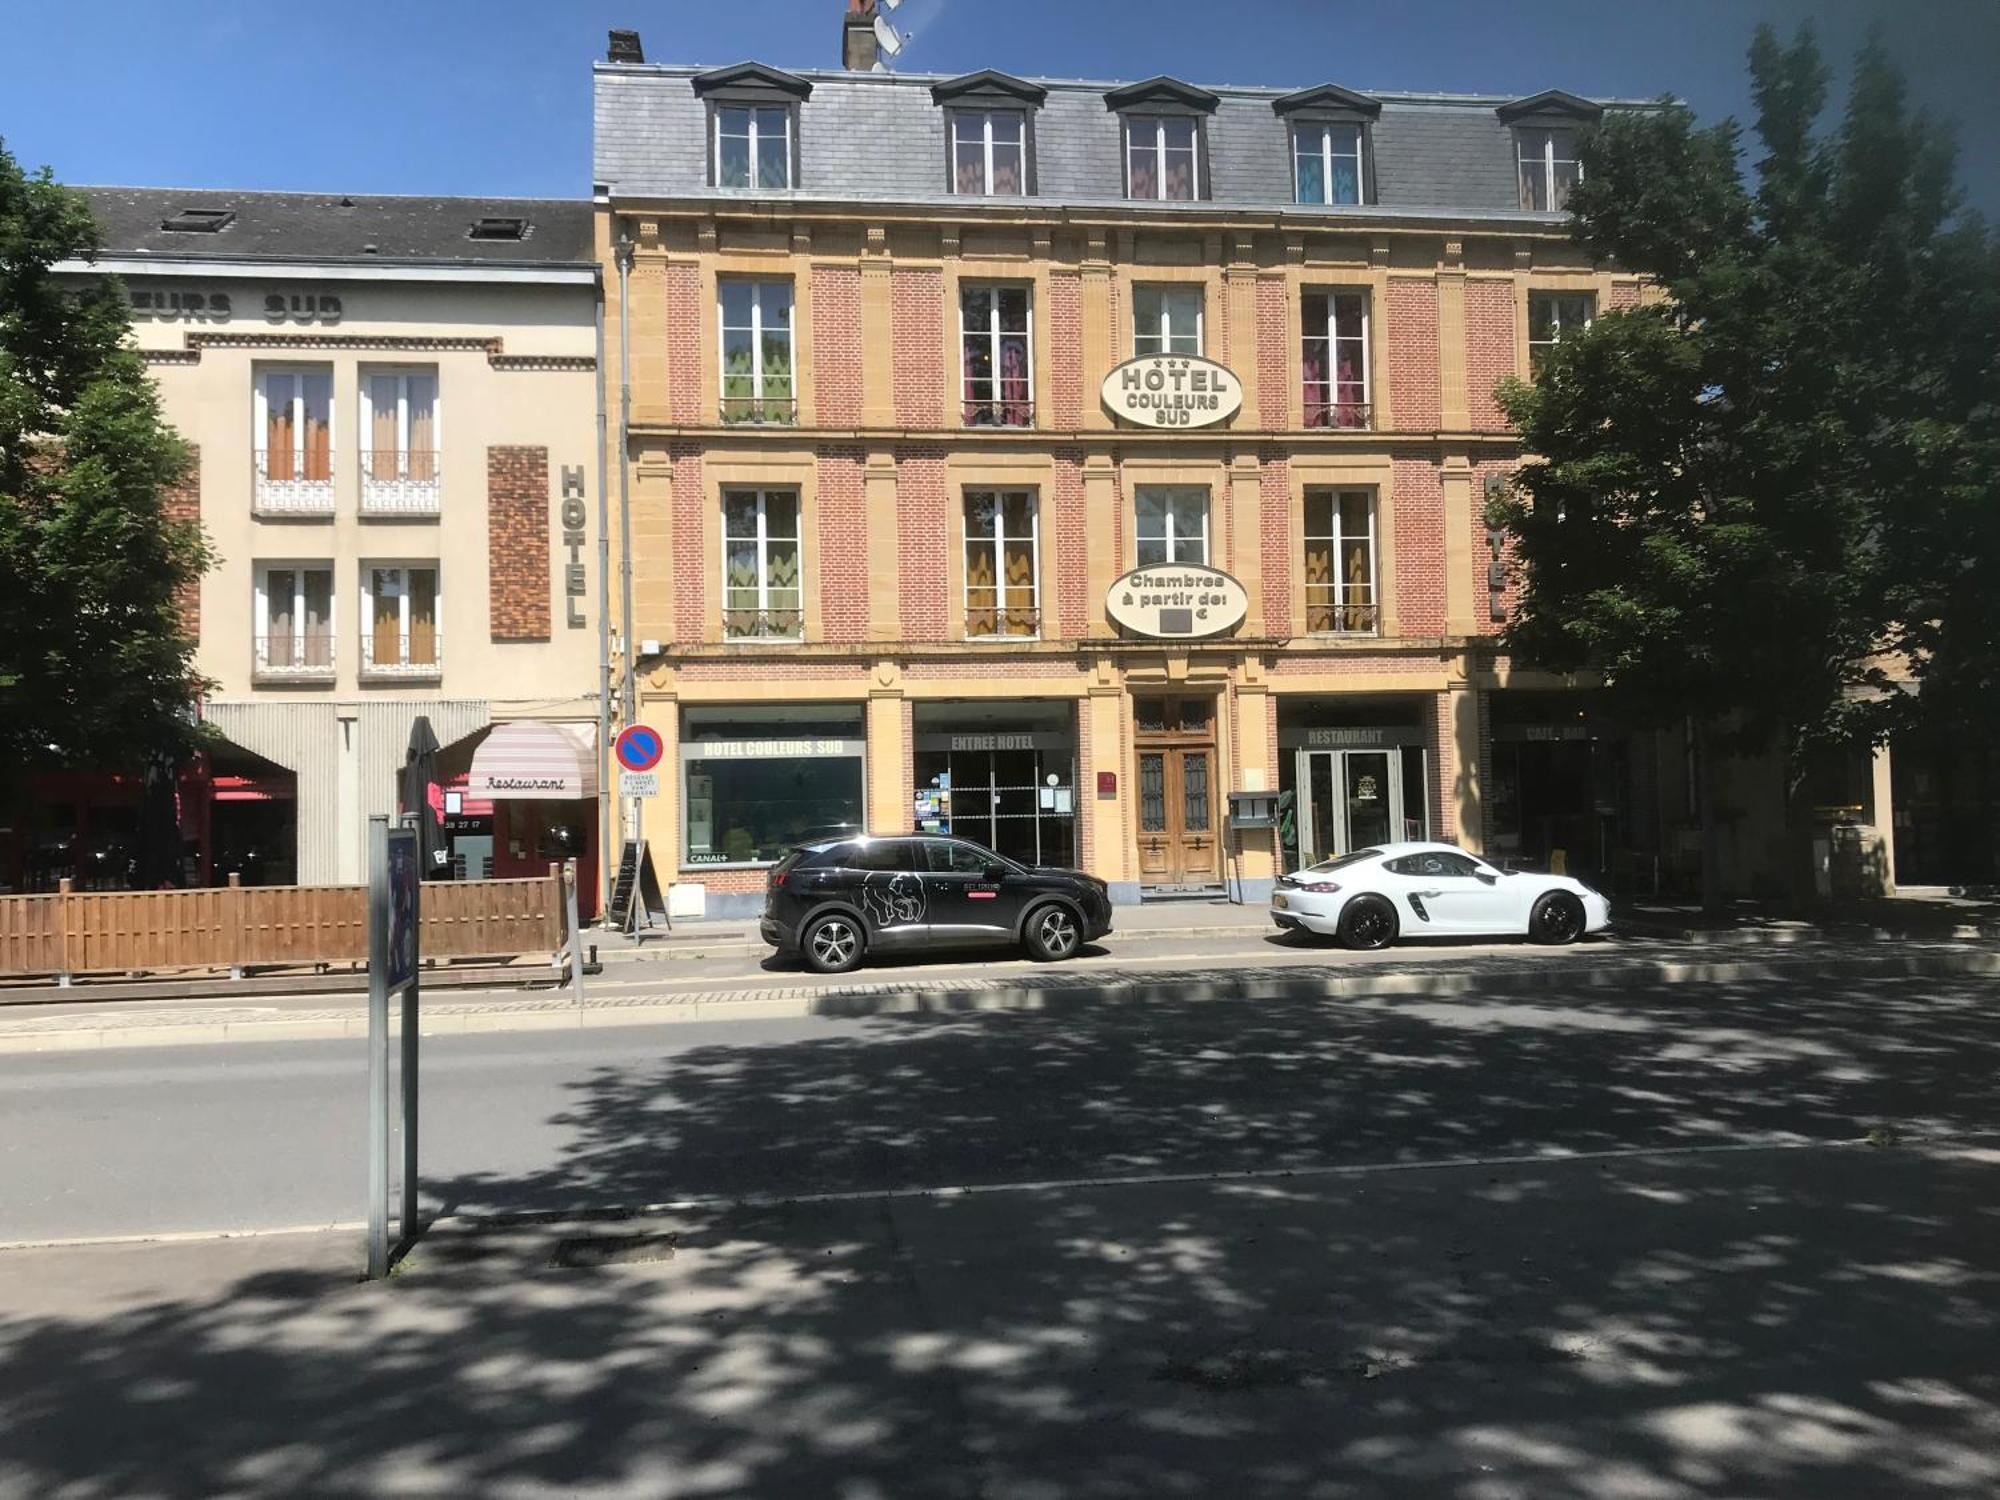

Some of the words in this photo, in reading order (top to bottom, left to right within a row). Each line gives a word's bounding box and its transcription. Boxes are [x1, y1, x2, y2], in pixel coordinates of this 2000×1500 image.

[264, 293, 343, 325] SUD
[1122, 368, 1227, 392] HOTEL
[1126, 393, 1219, 409] COULEURS
[1155, 410, 1190, 425] SUD
[561, 465, 586, 629] HOTEL
[1484, 471, 1507, 623] HTEL
[1130, 574, 1225, 588] Chambres
[1122, 592, 1134, 606] à
[1140, 592, 1194, 608] partir
[952, 736, 995, 750] ENTREE
[998, 735, 1034, 749] HOTEL
[1308, 730, 1383, 745] RESTAURANT
[704, 742, 742, 756] HOTEL
[746, 741, 812, 755] COULEURS
[817, 740, 843, 754] SUD
[486, 777, 565, 791] Restaurant
[690, 855, 728, 863] CANAL+
